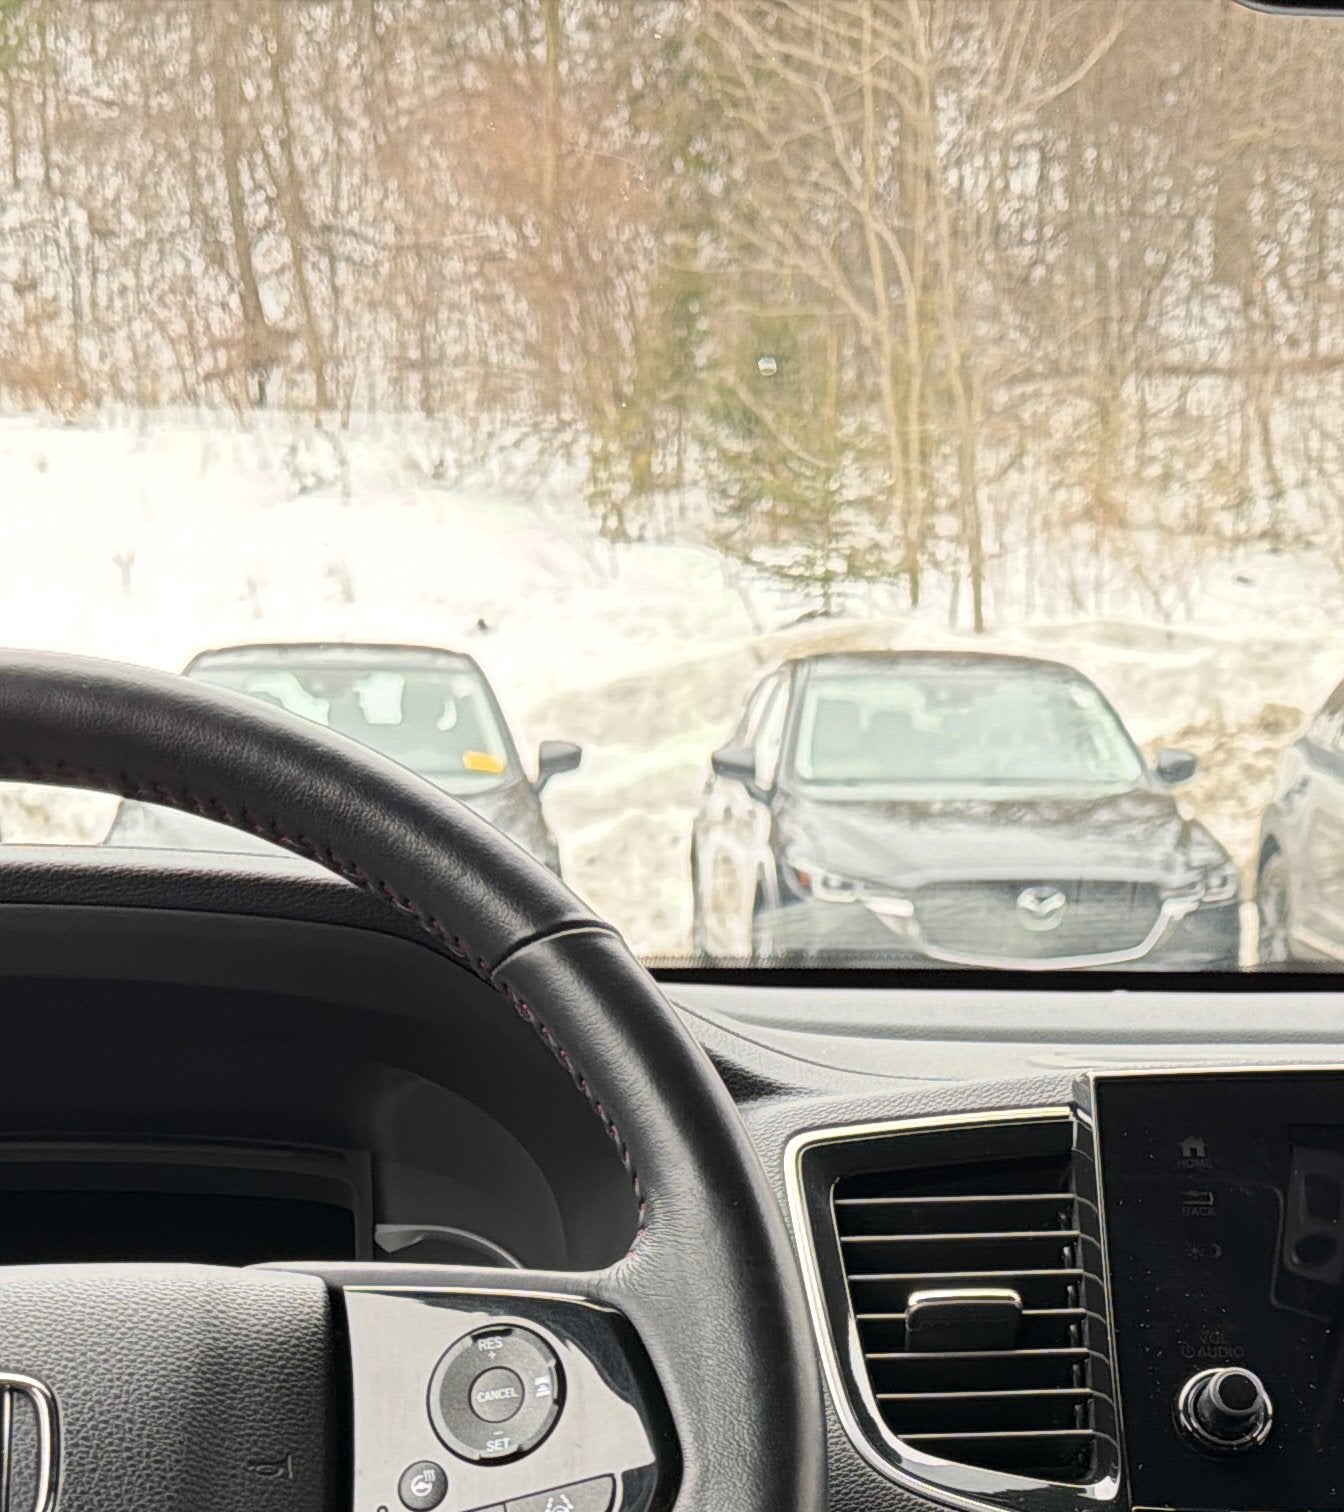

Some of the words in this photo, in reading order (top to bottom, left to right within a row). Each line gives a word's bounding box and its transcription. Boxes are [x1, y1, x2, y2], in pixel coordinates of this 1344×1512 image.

[1181, 1206, 1217, 1217] BACK
[477, 1336, 505, 1352] RES
[476, 1386, 519, 1403] CANCEL
[485, 1437, 511, 1453] SET
